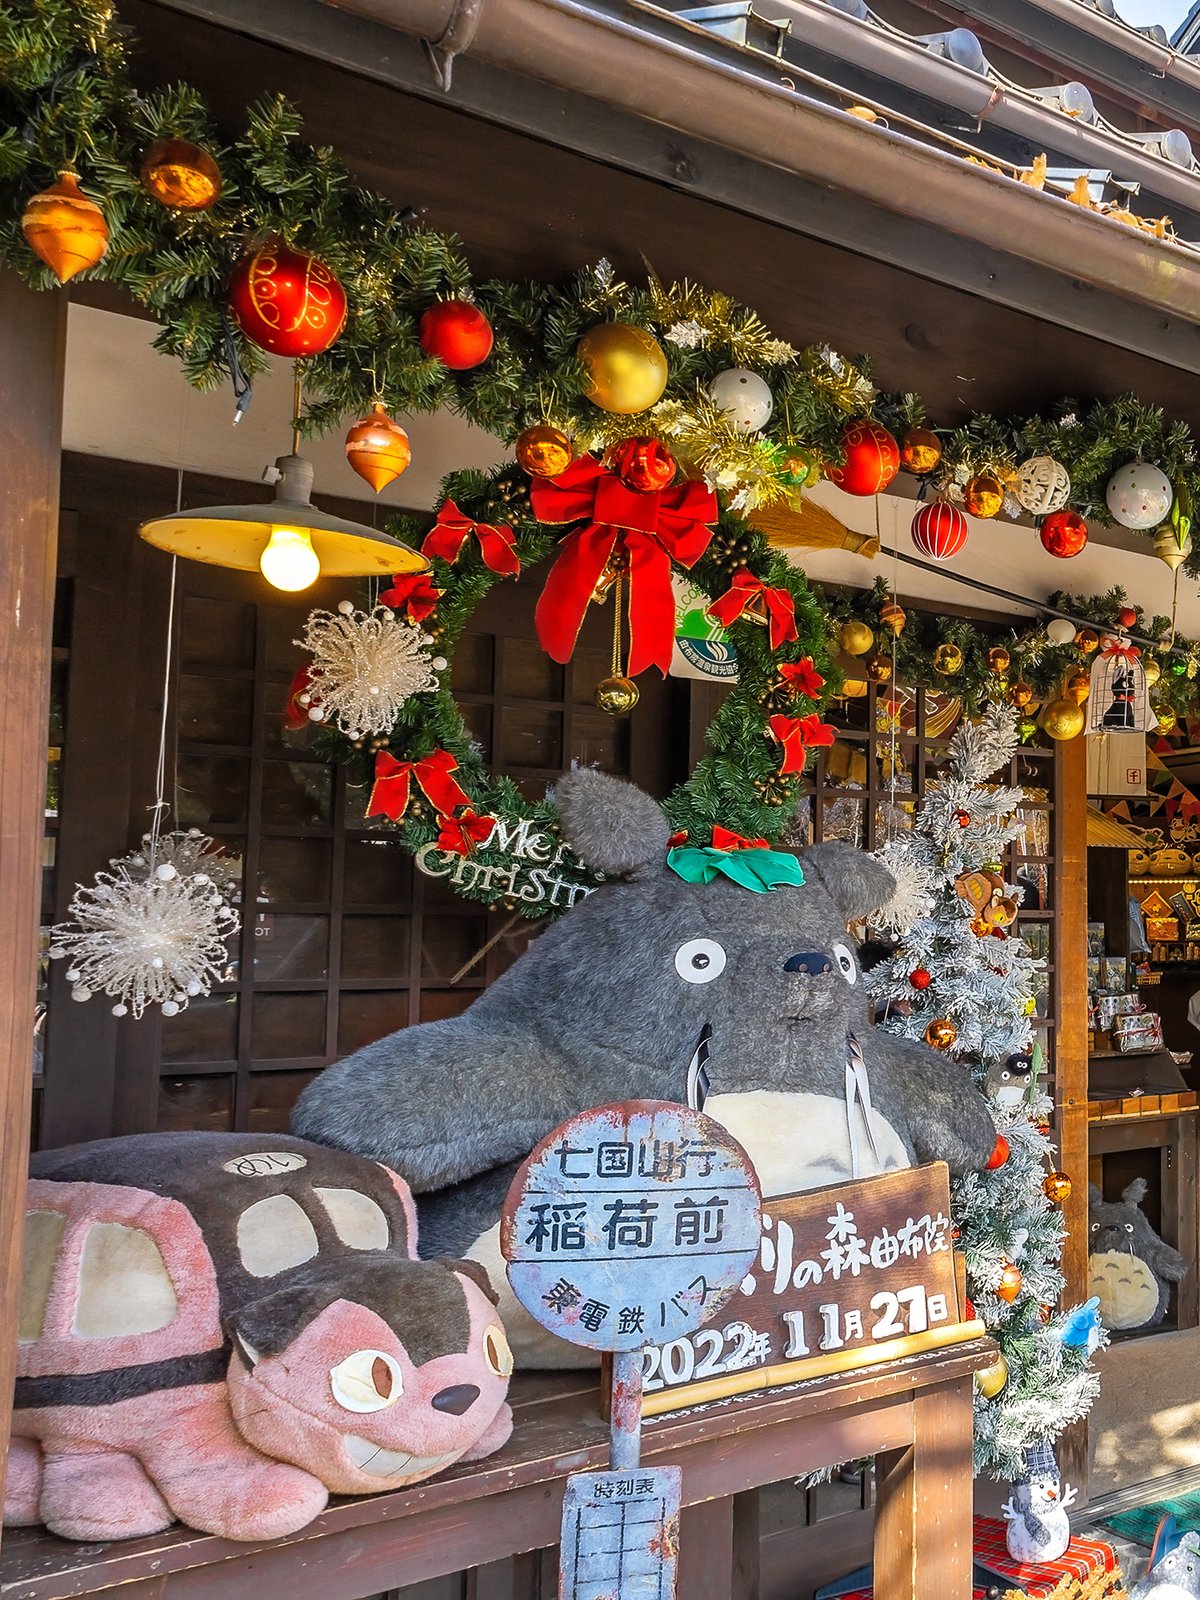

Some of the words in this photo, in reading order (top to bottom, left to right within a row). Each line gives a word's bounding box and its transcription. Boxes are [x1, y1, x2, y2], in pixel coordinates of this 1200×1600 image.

[675, 588, 702, 628] WELCO
[554, 1139, 717, 1179] 七国山行
[525, 1196, 729, 1252] 稲荷前
[593, 1477, 656, 1499] 時刻表
